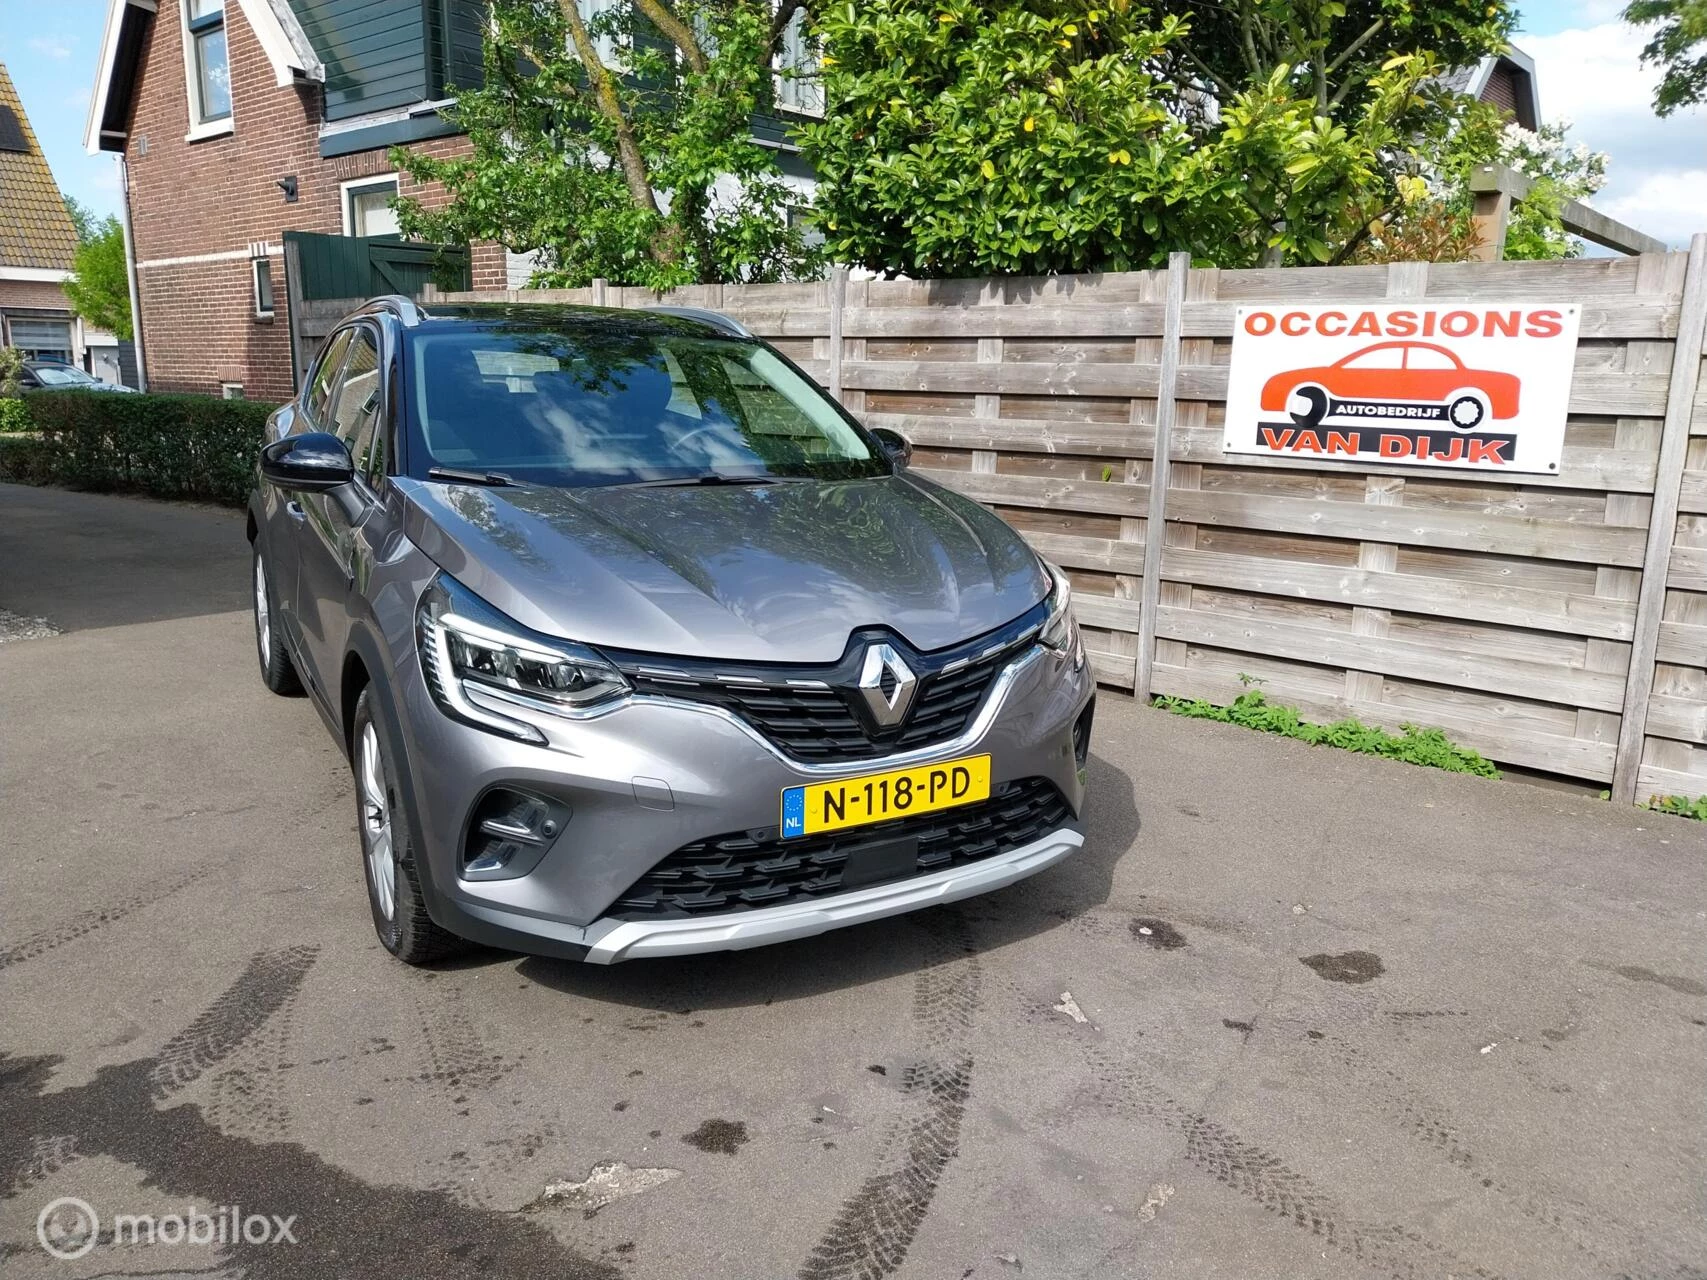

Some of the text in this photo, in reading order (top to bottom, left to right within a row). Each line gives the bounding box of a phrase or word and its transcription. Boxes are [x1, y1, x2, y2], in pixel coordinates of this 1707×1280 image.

[1244, 310, 1563, 338] OCCASIONS
[1335, 404, 1441, 419] AUTOBEDRIJF
[1261, 427, 1511, 465] VAN DIJK
[823, 766, 971, 823] N-118-PD
[786, 816, 802, 828] NL
